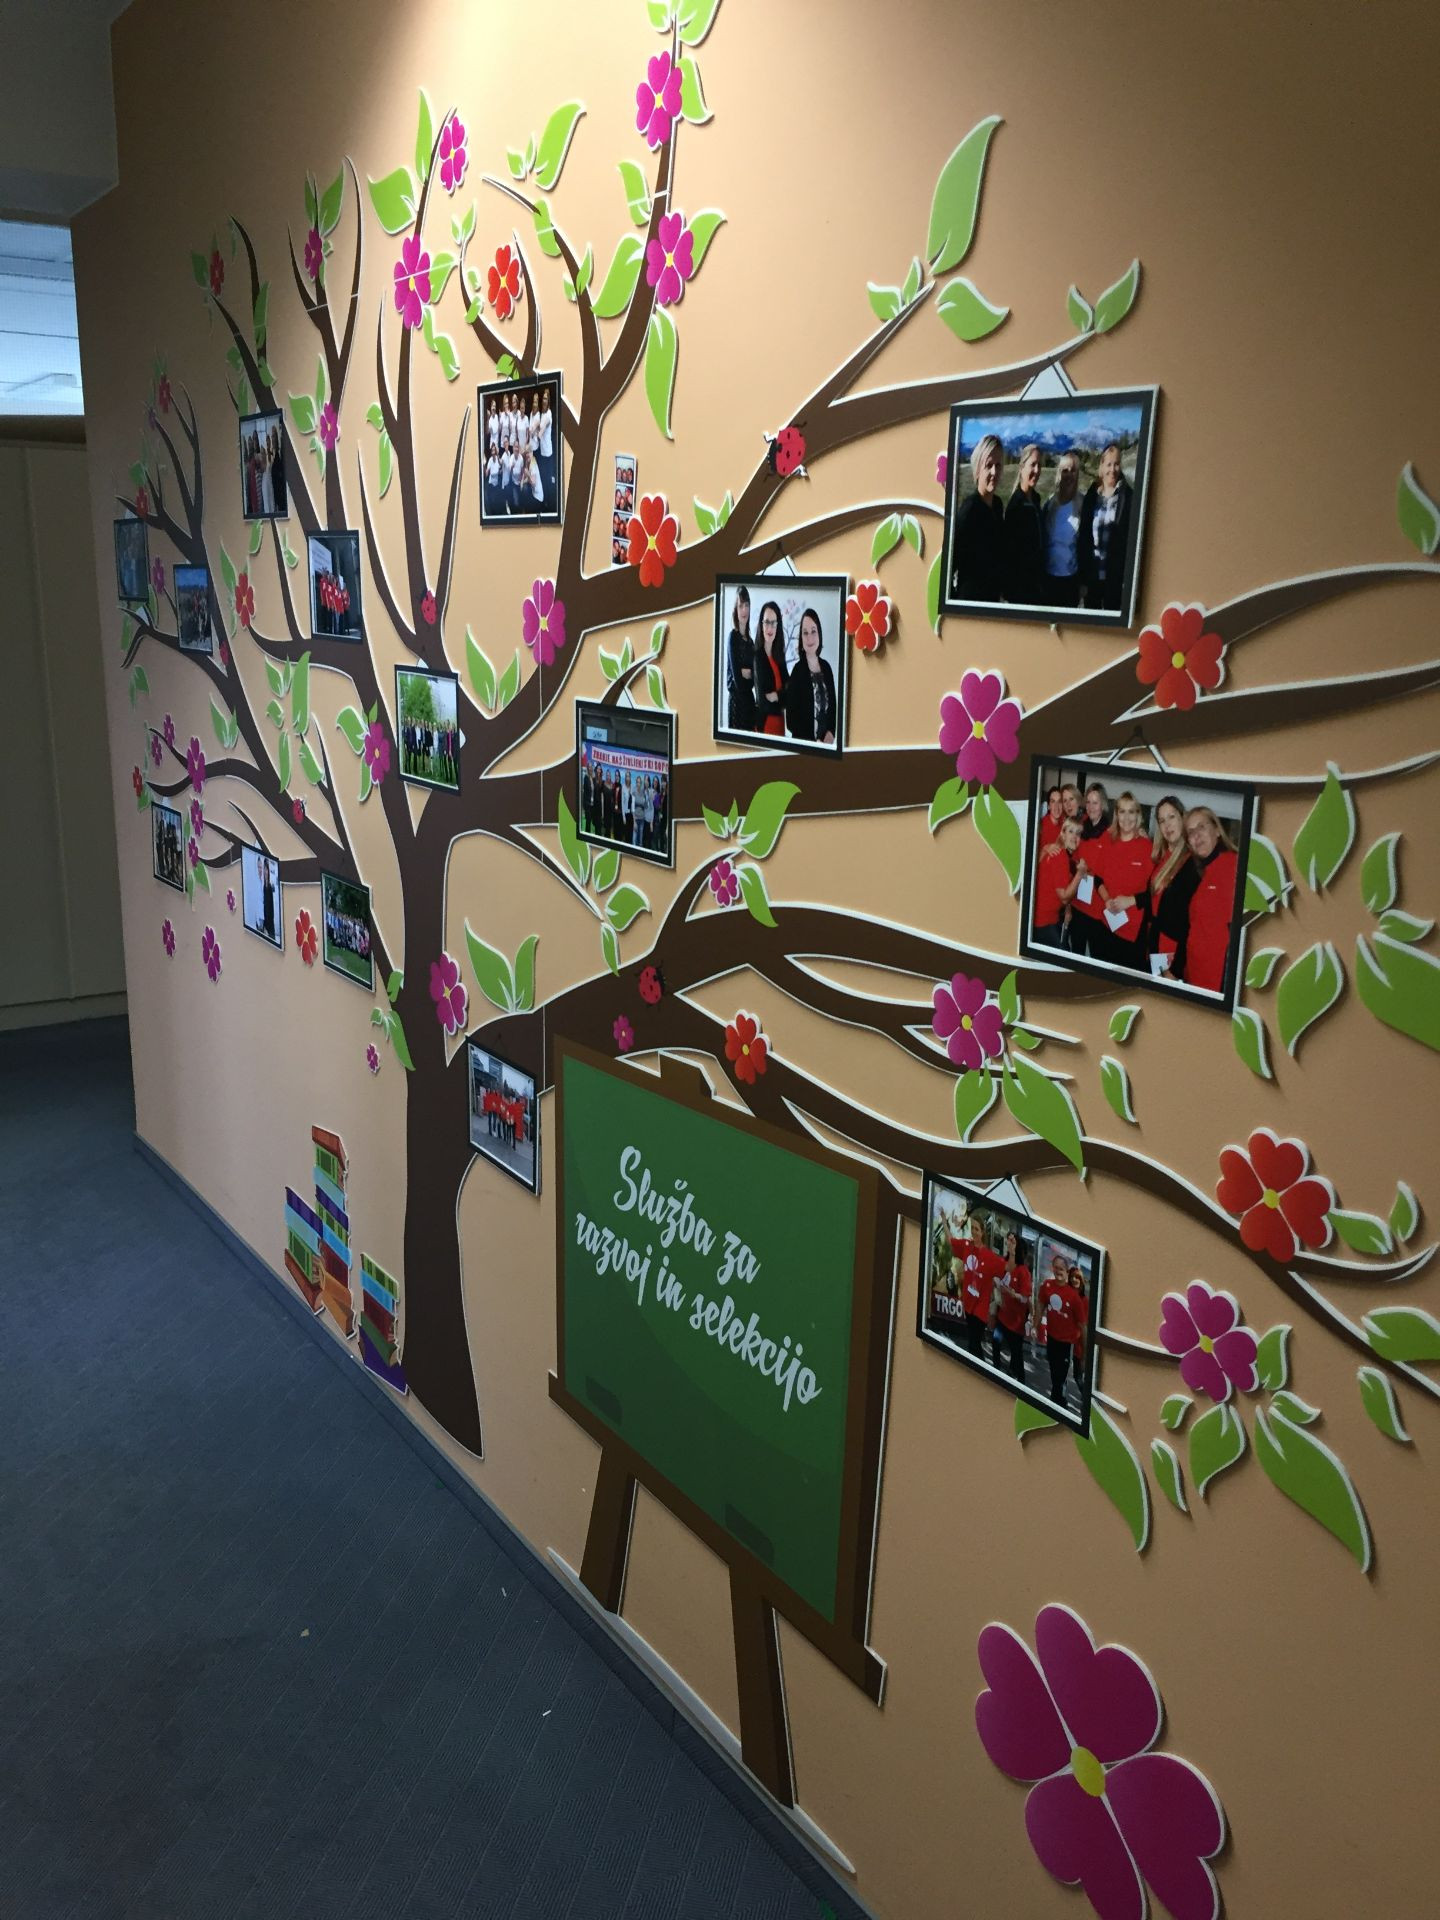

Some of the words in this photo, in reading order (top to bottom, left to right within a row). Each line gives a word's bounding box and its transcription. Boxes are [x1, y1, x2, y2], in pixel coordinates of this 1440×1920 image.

[613, 1145, 717, 1256] Služba
[716, 1230, 762, 1286] za
[575, 1212, 652, 1306] razvoj
[656, 1255, 687, 1312] in
[689, 1294, 823, 1412] selekcijo
[934, 1293, 966, 1318] TRGO
